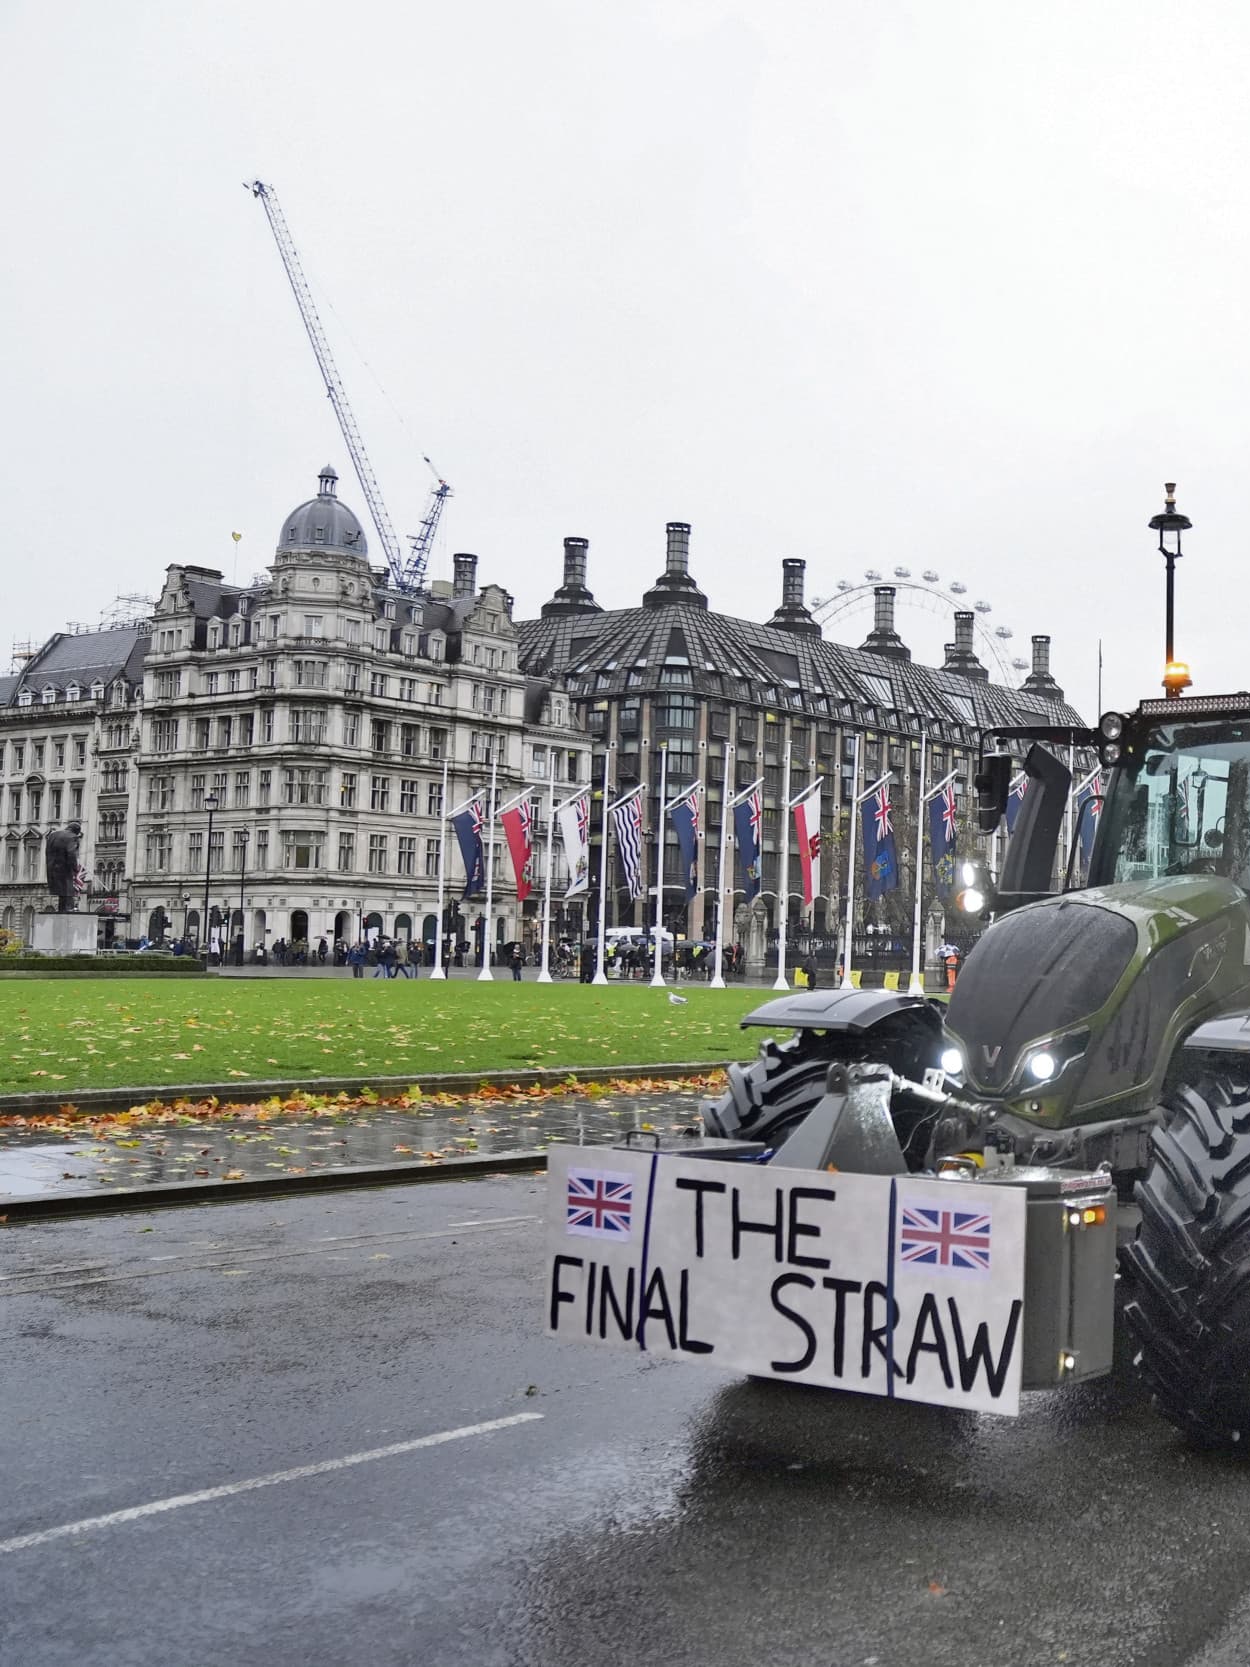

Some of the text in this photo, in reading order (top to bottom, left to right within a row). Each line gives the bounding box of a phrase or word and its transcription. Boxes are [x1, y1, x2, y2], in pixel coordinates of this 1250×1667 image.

[675, 1177, 837, 1270] THE
[550, 1254, 1023, 1398] FINAL STRAW
